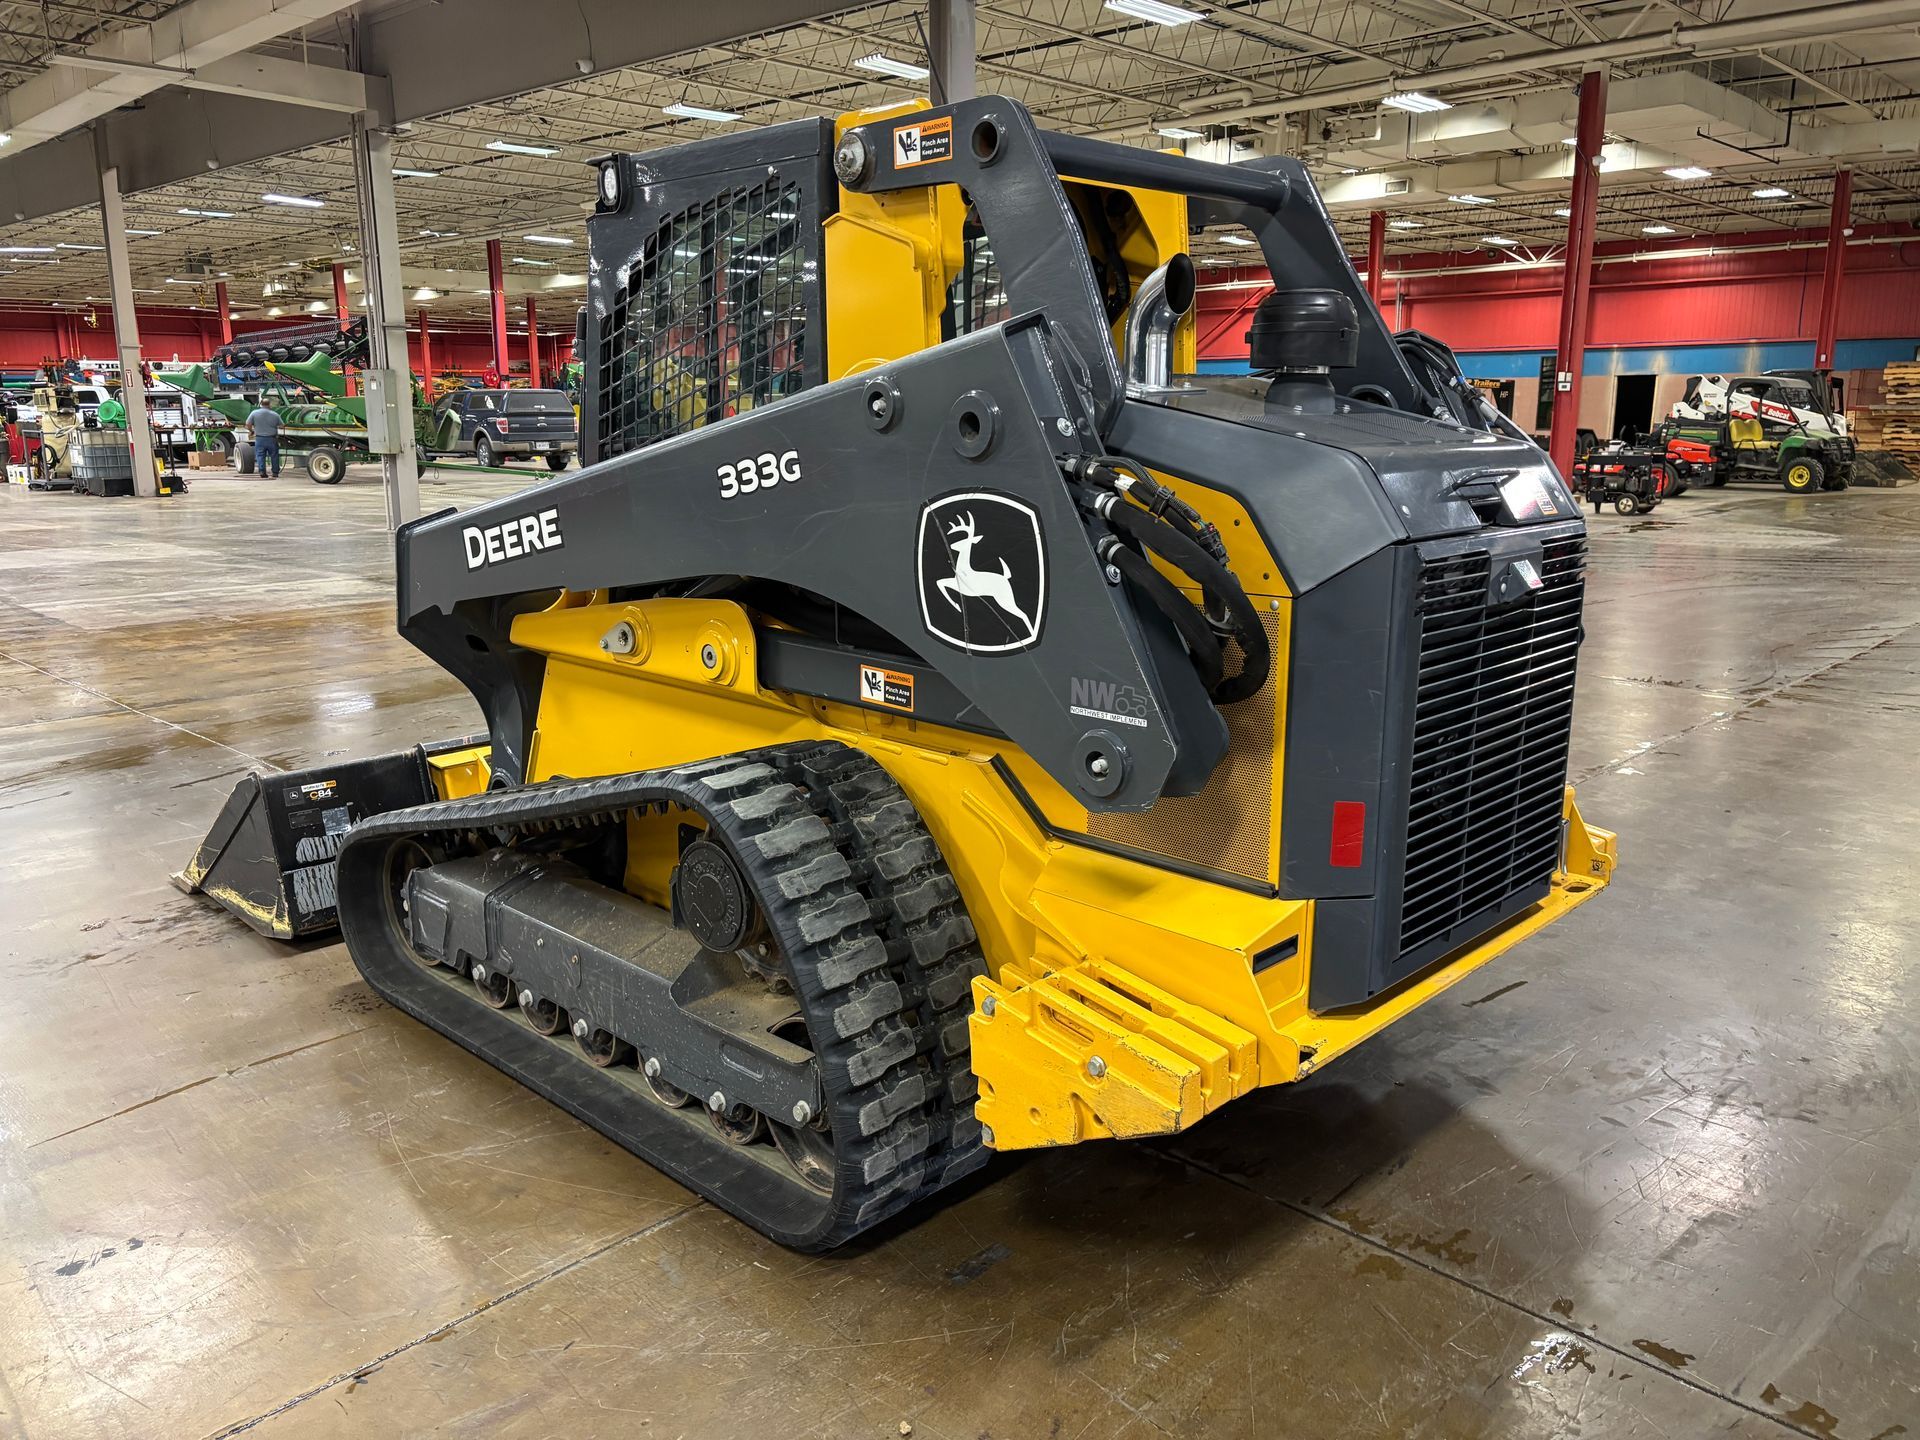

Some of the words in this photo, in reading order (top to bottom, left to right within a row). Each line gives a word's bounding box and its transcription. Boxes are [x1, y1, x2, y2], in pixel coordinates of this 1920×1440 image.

[926, 121, 949, 131] WARNING
[921, 138, 936, 148] Pinch
[936, 137, 949, 145] Area
[1474, 379, 1501, 388] Trailers
[1767, 408, 1790, 420] Bobcat
[717, 450, 801, 498] 333G
[462, 508, 562, 569] DEERE
[889, 674, 911, 683] WARNING
[885, 685, 899, 694] Pinch
[899, 688, 910, 696] Area
[1070, 676, 1116, 711] NW
[896, 696, 907, 704] Away
[1070, 706, 1109, 719] NORTHWEST
[1109, 714, 1146, 726] IMPLEMENT
[309, 788, 332, 799] C84
